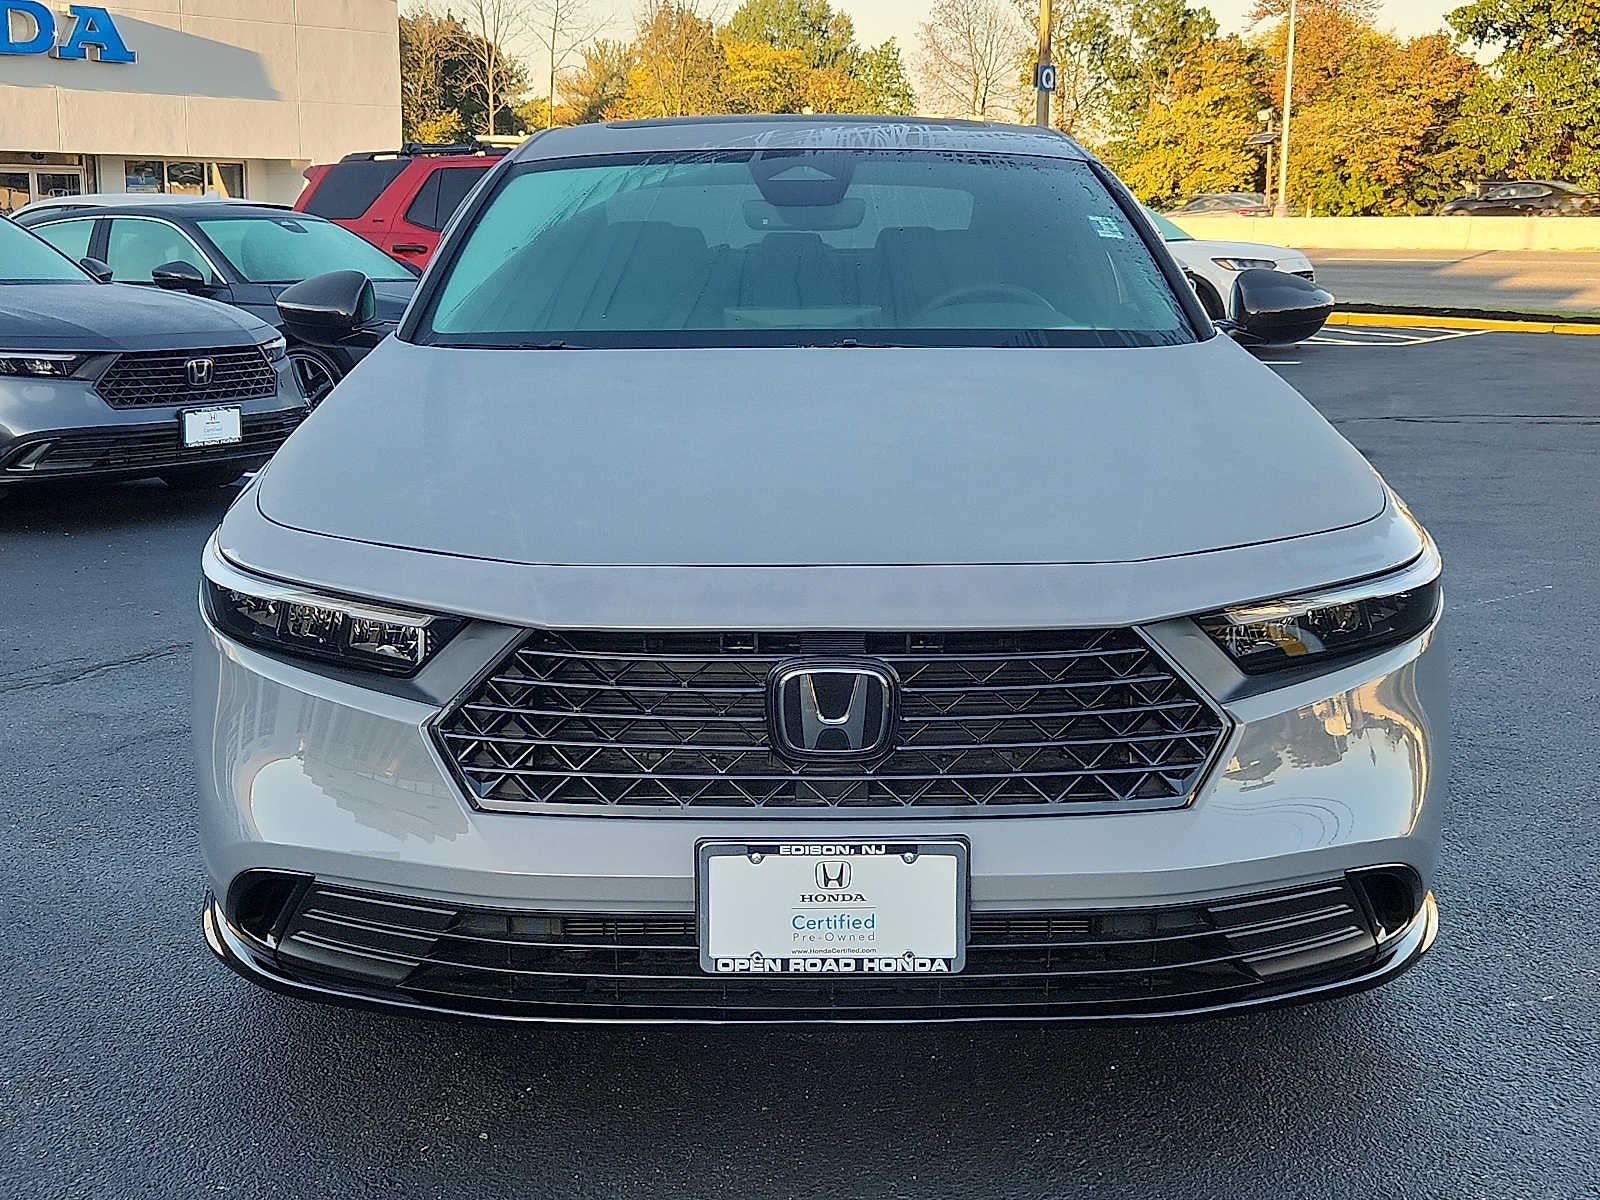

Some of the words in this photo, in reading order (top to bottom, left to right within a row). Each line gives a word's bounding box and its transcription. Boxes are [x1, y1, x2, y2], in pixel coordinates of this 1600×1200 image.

[1042, 69, 1054, 89] Q
[780, 845, 855, 855] EDISON,
[861, 844, 886, 854] NJ
[800, 893, 867, 903] HONDA
[792, 913, 875, 930] Certified
[793, 931, 875, 942] Pre-Owned
[791, 946, 877, 955] www.HondaCertified.com
[717, 958, 782, 972] OPEN
[789, 958, 856, 972] ROAD
[863, 958, 949, 972] HONDA
